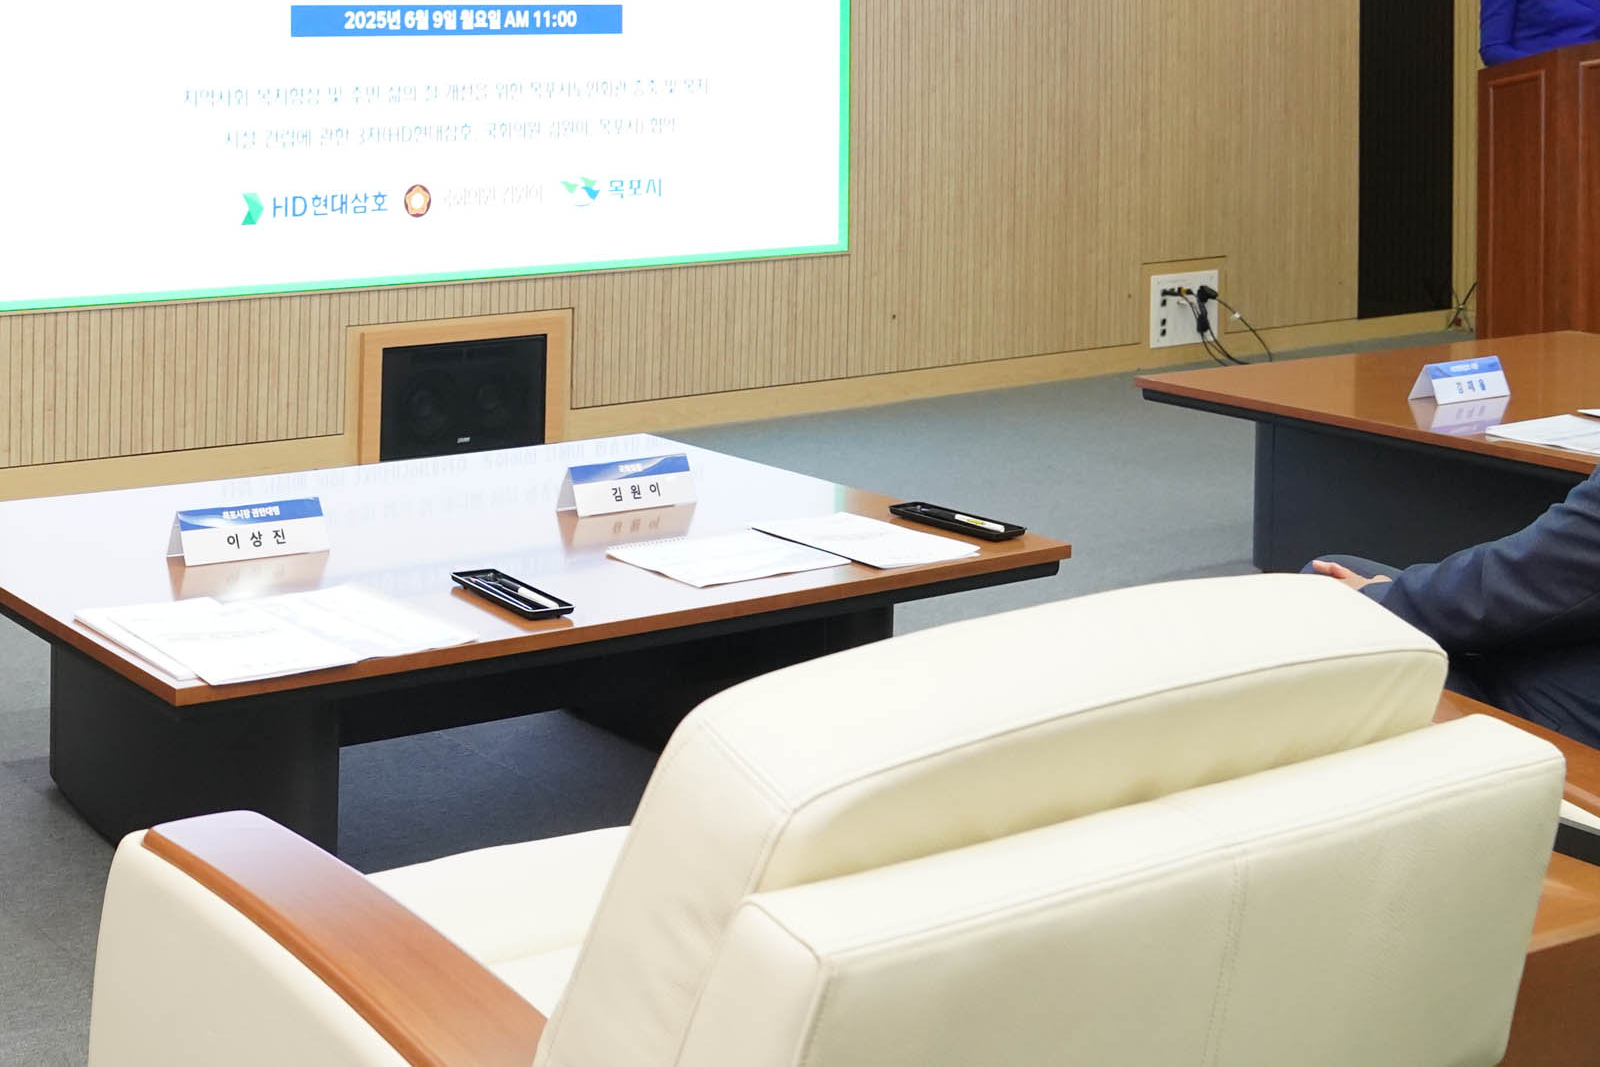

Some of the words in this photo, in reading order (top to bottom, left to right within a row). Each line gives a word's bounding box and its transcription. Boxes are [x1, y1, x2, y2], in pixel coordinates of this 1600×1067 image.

[344, 10, 400, 30] 2025년
[404, 9, 428, 30] 6월
[432, 9, 456, 30] 9일
[504, 10, 529, 28] AM
[533, 10, 577, 28] 11:00
[607, 177, 663, 199] 목포시
[272, 190, 389, 219] HD현대삼호
